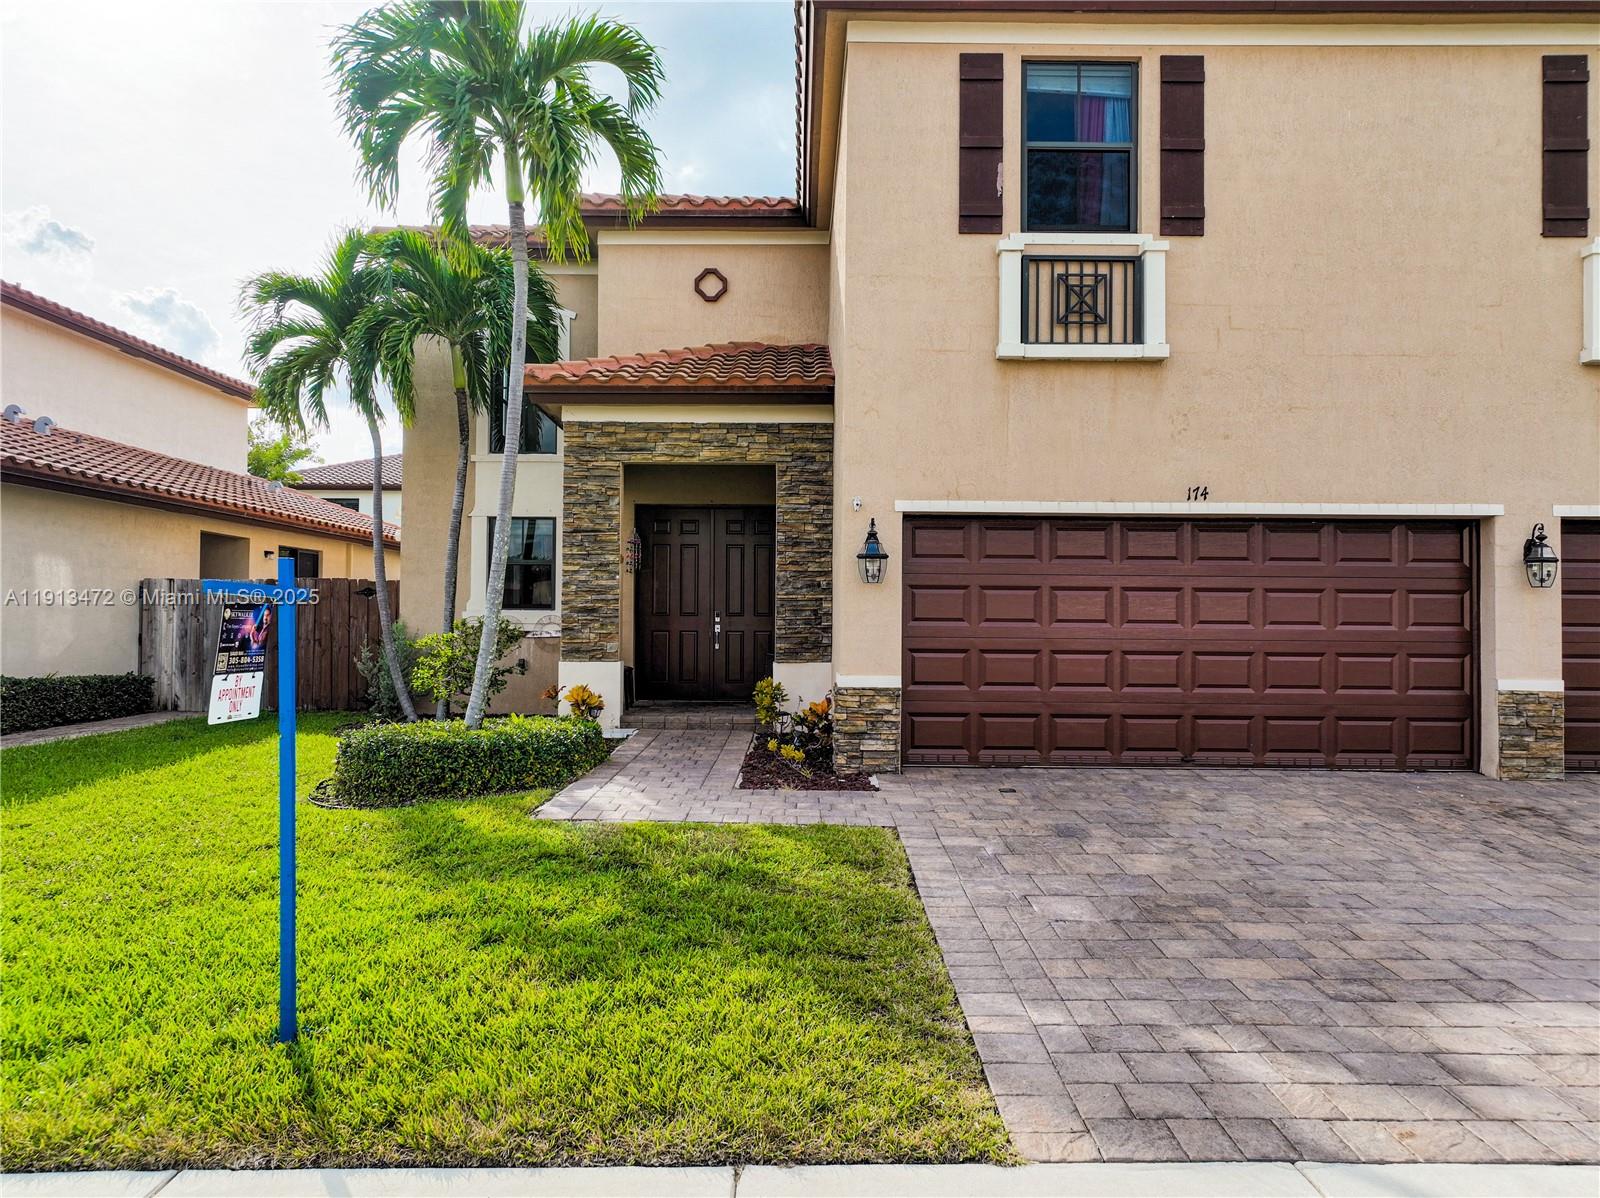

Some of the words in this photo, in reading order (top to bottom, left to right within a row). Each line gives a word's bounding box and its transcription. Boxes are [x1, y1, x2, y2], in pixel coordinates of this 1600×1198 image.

[1186, 485, 1209, 501] 174
[234, 674, 243, 687] BY
[218, 686, 255, 701] APPOINTMENT
[228, 700, 243, 712] ONLY
